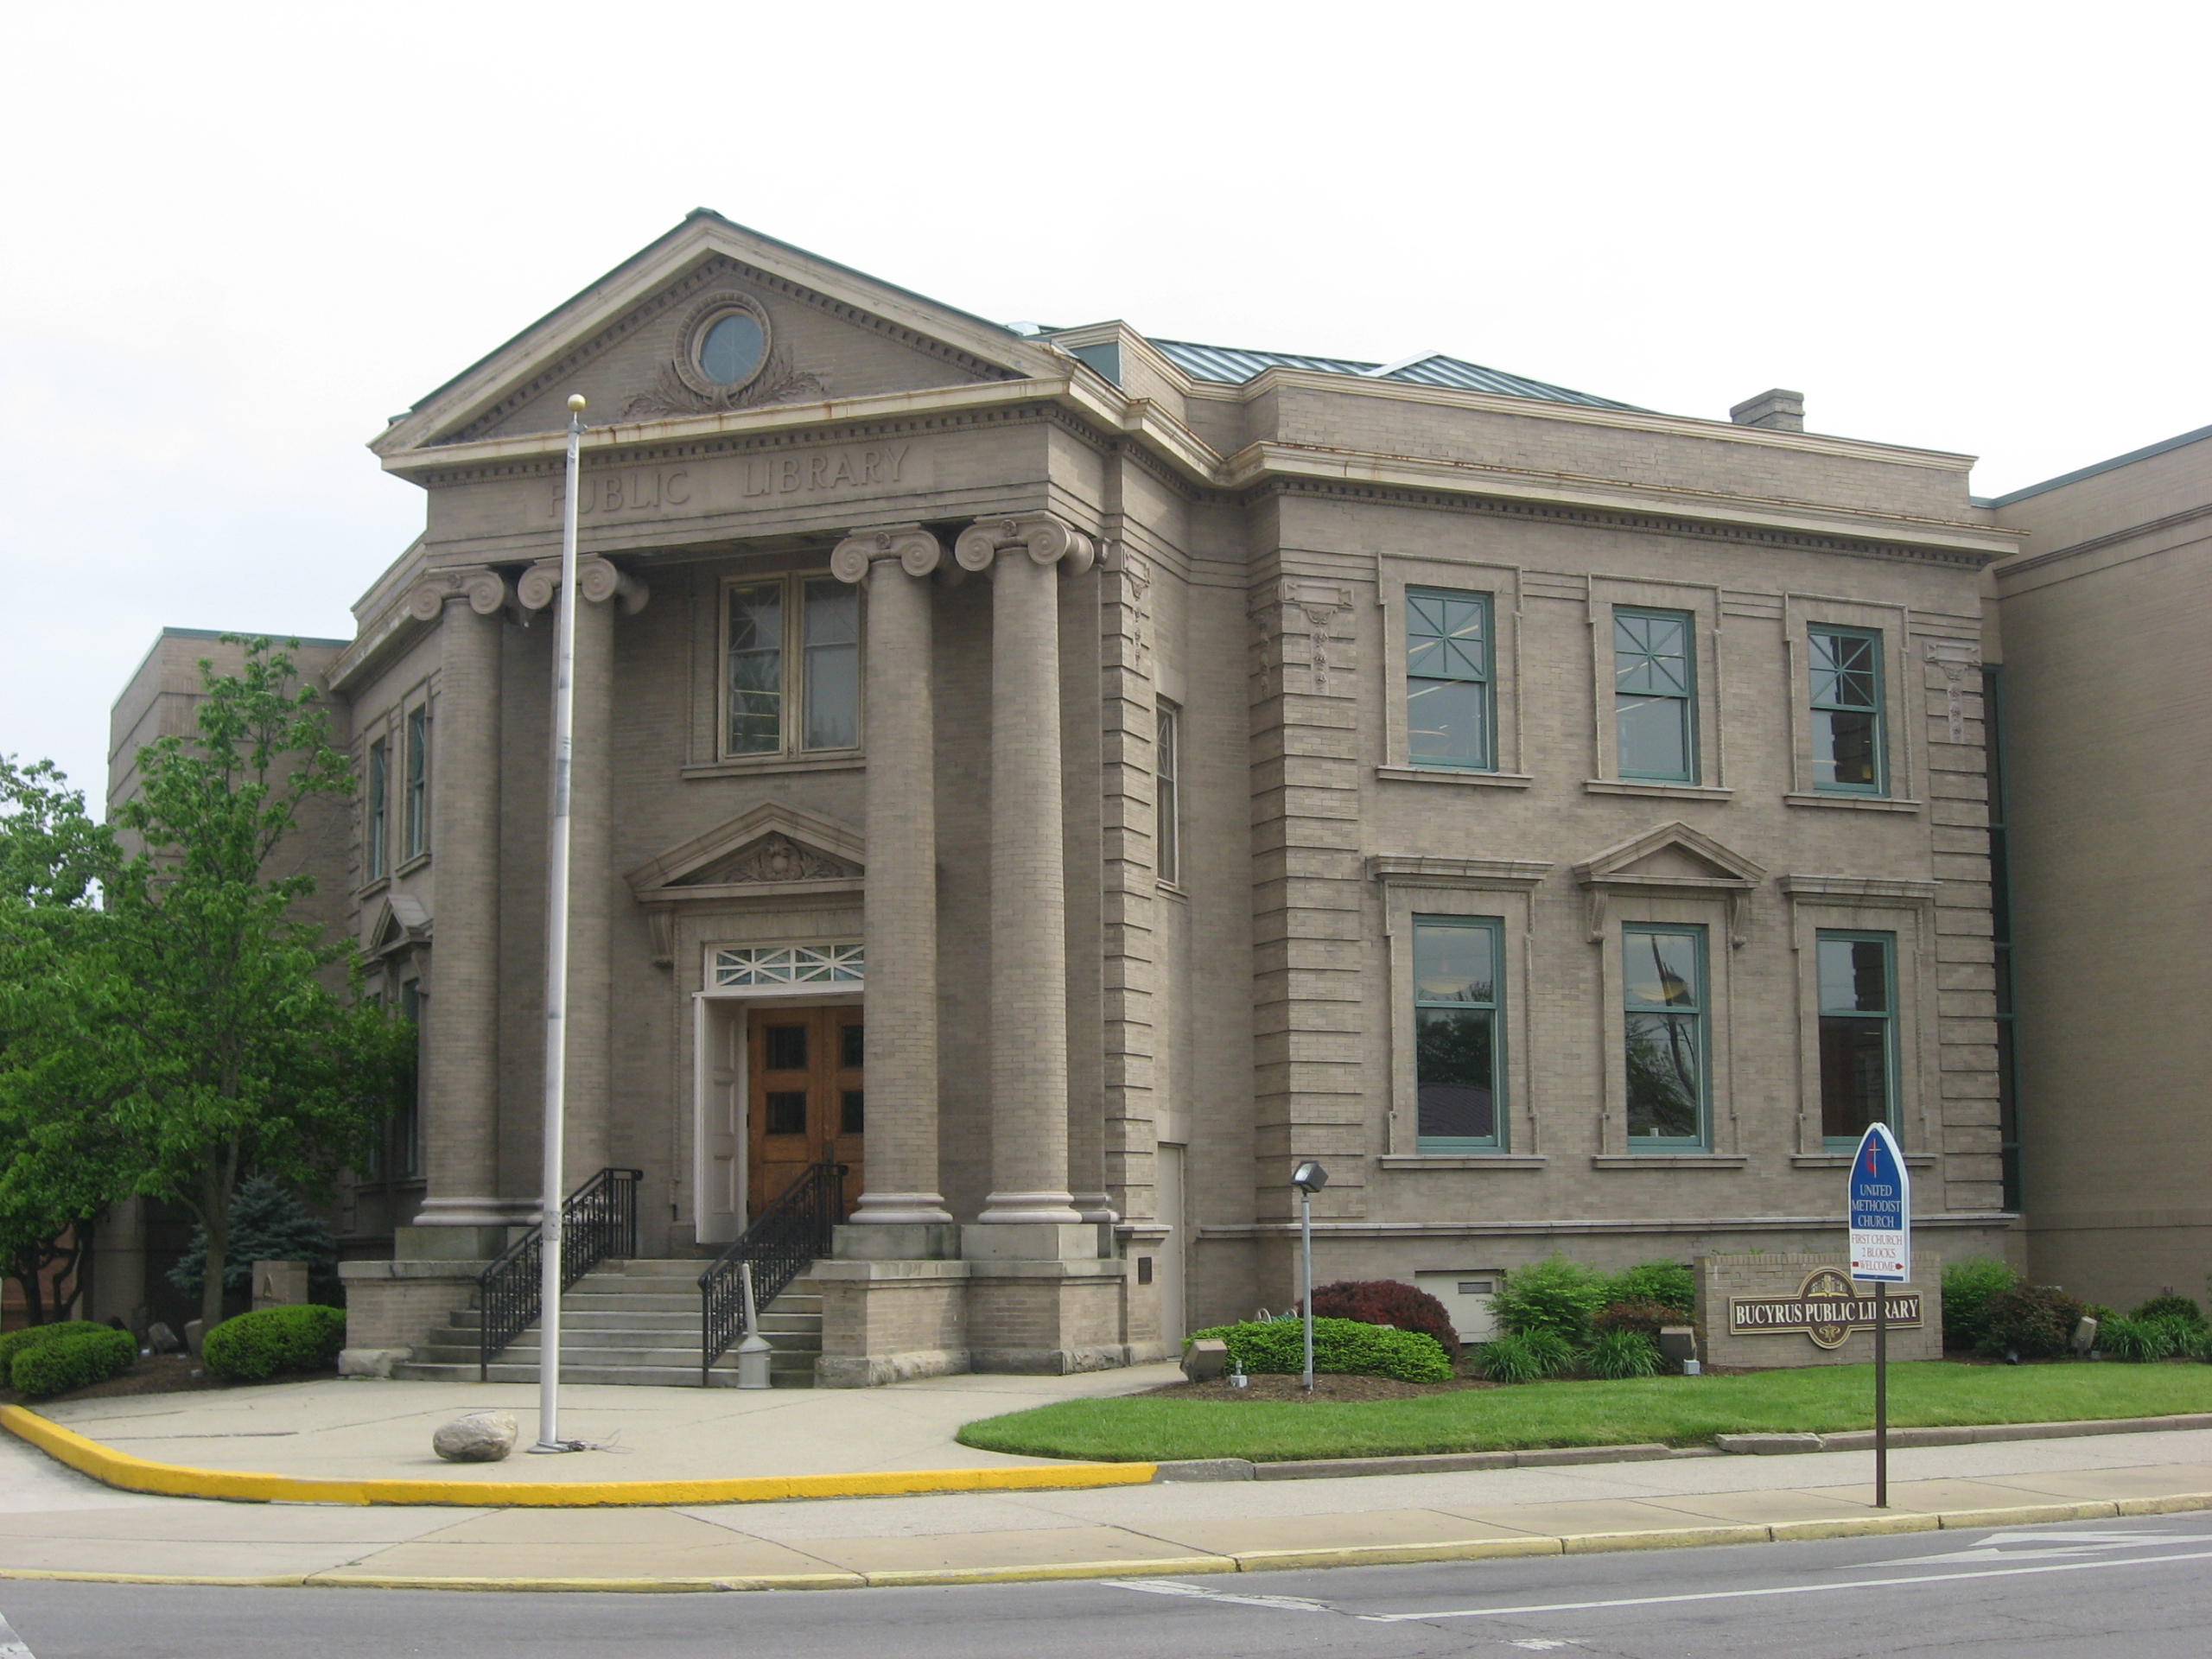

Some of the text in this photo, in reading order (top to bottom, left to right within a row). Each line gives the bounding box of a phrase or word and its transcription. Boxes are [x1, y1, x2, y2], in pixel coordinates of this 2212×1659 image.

[549, 447, 910, 518] PUBLIC LIBRARY
[1859, 1184, 1892, 1197] UNITED
[1852, 1199, 1901, 1213] METHODIST
[1858, 1215, 1894, 1228] CHURCH
[1852, 1234, 1903, 1246] FIRST CHURCH
[1862, 1247, 1896, 1258] 2 BLOCKS
[1859, 1261, 1896, 1272] WELCOME
[1736, 1304, 1802, 1325] BUCYRUS
[1805, 1302, 1856, 1322] PUBLIC
